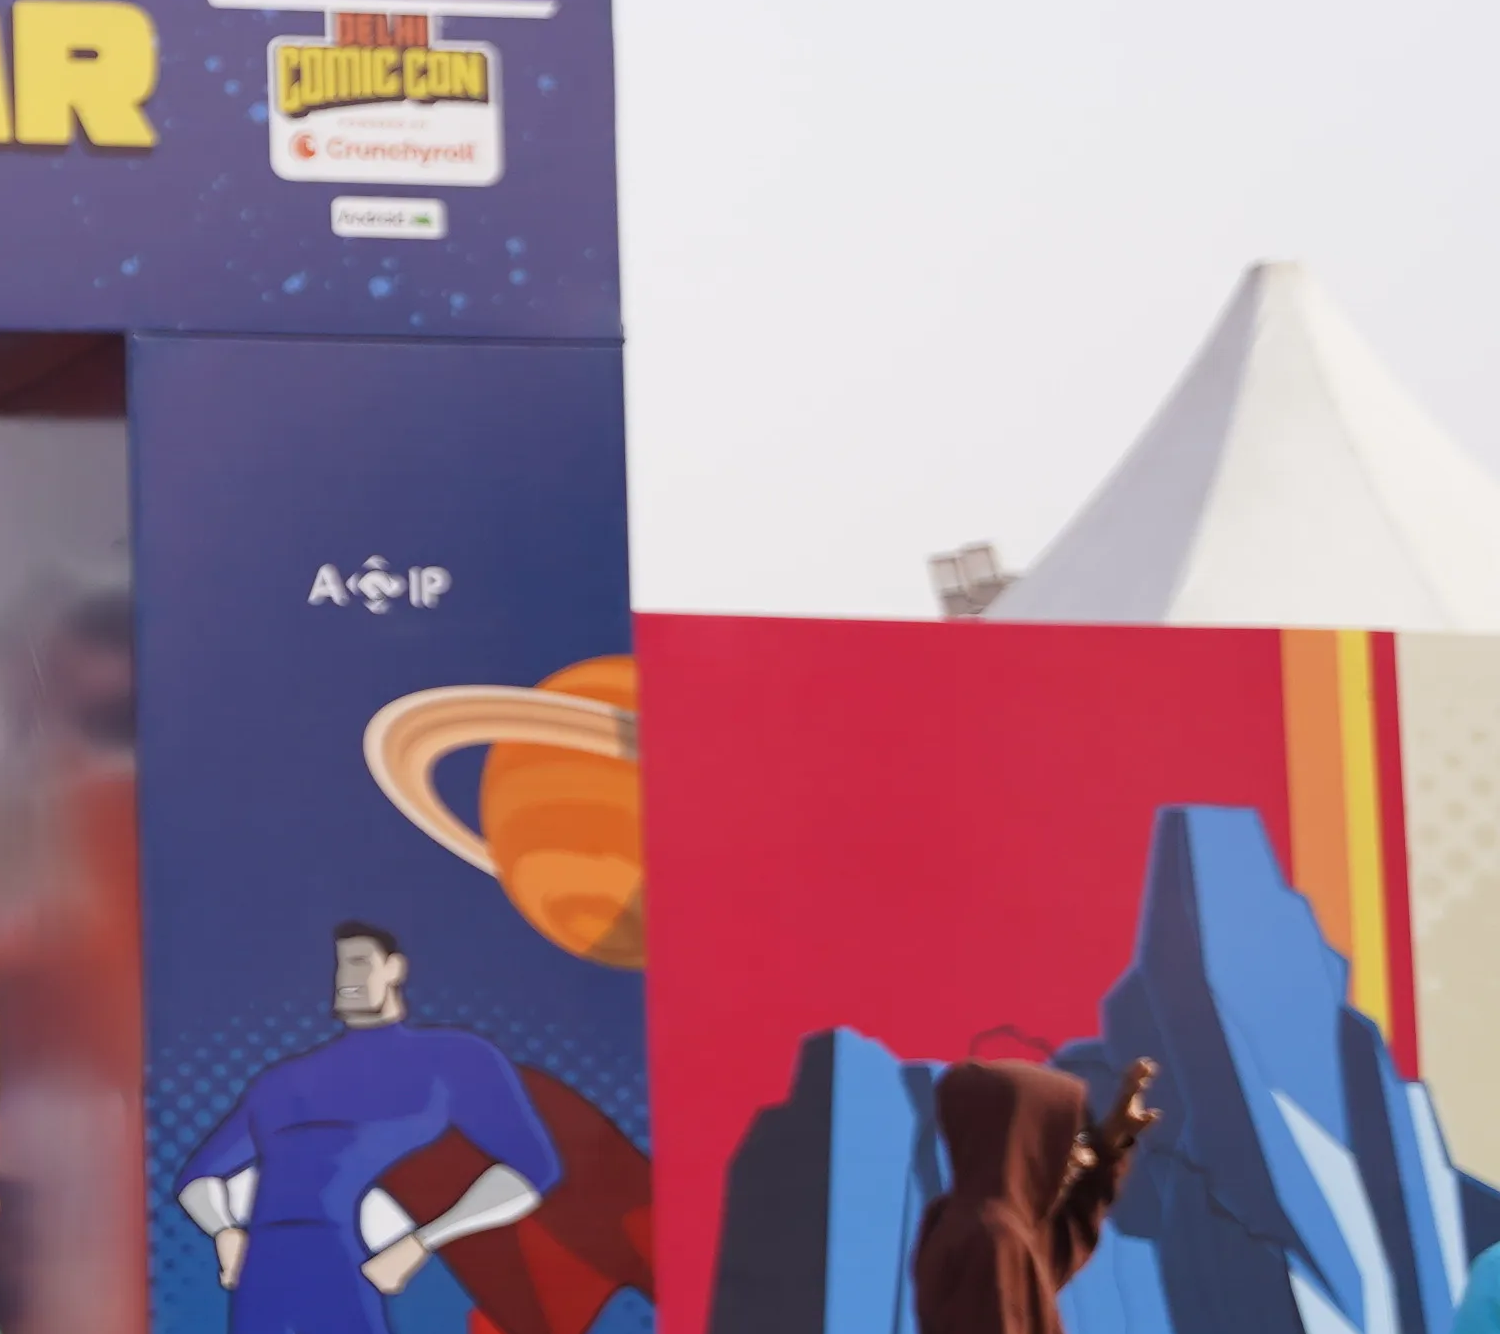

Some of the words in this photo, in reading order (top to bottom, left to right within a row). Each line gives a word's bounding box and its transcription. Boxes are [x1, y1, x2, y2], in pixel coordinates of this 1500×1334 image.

[336, 12, 428, 46] DELHI
[279, 45, 402, 115] COMIC
[402, 48, 488, 105] CON
[325, 136, 476, 167] Crunchyroll
